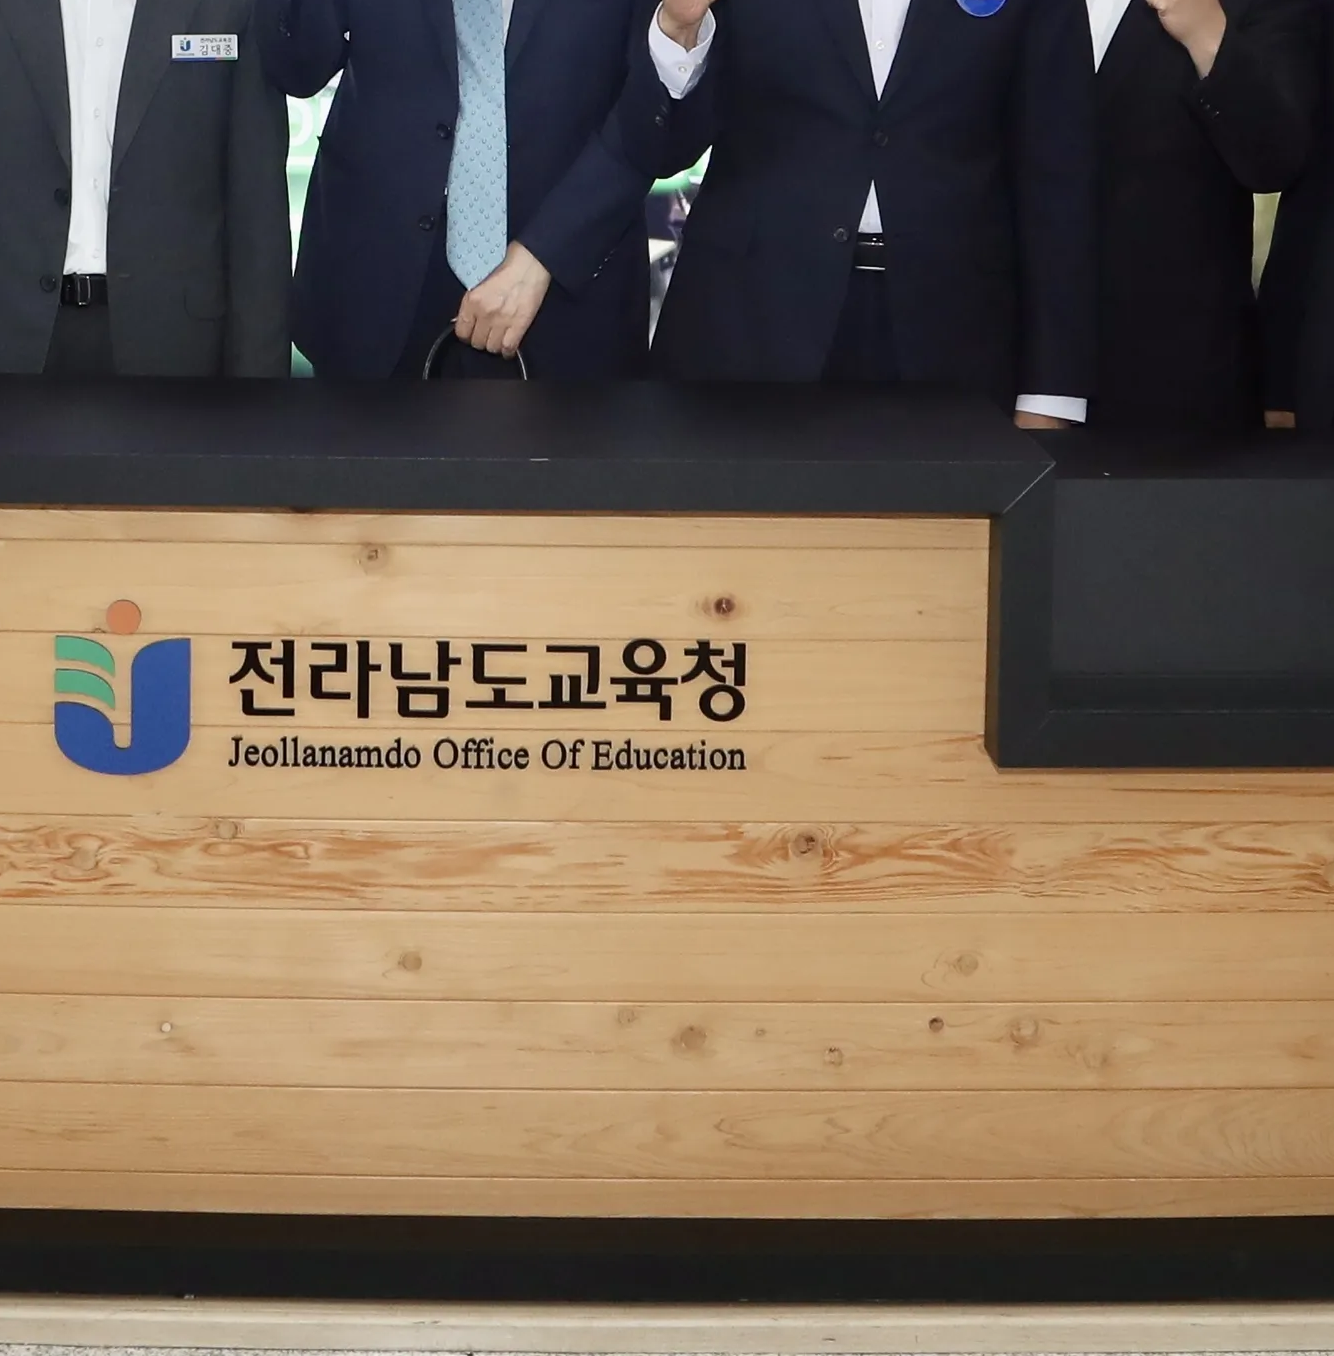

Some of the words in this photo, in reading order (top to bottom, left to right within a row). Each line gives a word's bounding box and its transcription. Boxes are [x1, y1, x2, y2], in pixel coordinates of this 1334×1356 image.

[227, 637, 748, 723] 전라남도교육청
[227, 736, 423, 770] Jeollanamdo
[432, 736, 531, 771] Office
[540, 736, 586, 771] Of
[591, 739, 748, 772] Education
